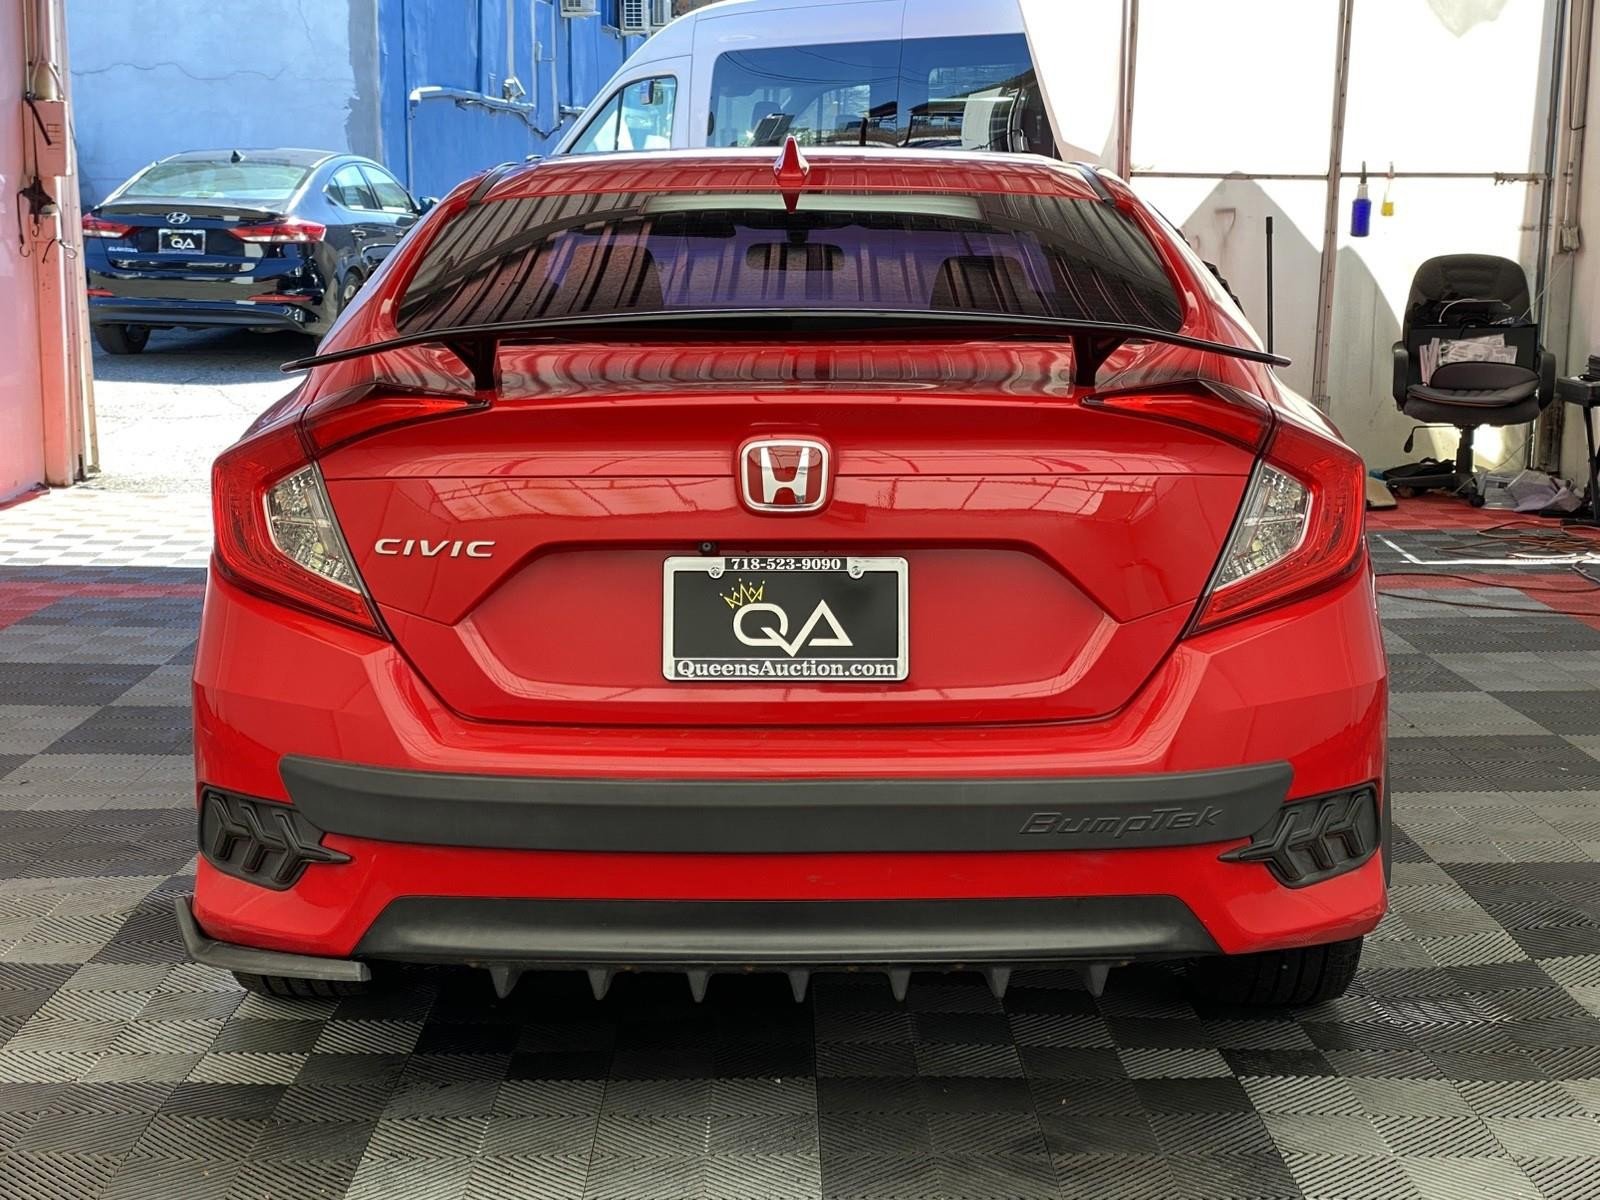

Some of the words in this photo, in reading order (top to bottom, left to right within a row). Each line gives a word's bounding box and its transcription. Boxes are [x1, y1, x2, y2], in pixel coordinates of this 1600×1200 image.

[171, 238, 196, 250] QA
[374, 538, 496, 558] CIVIC
[731, 558, 841, 570] 718-523-9090
[733, 599, 853, 657] QA
[677, 660, 896, 677] QueensAuction.com
[1019, 806, 1223, 839] BumpTek
